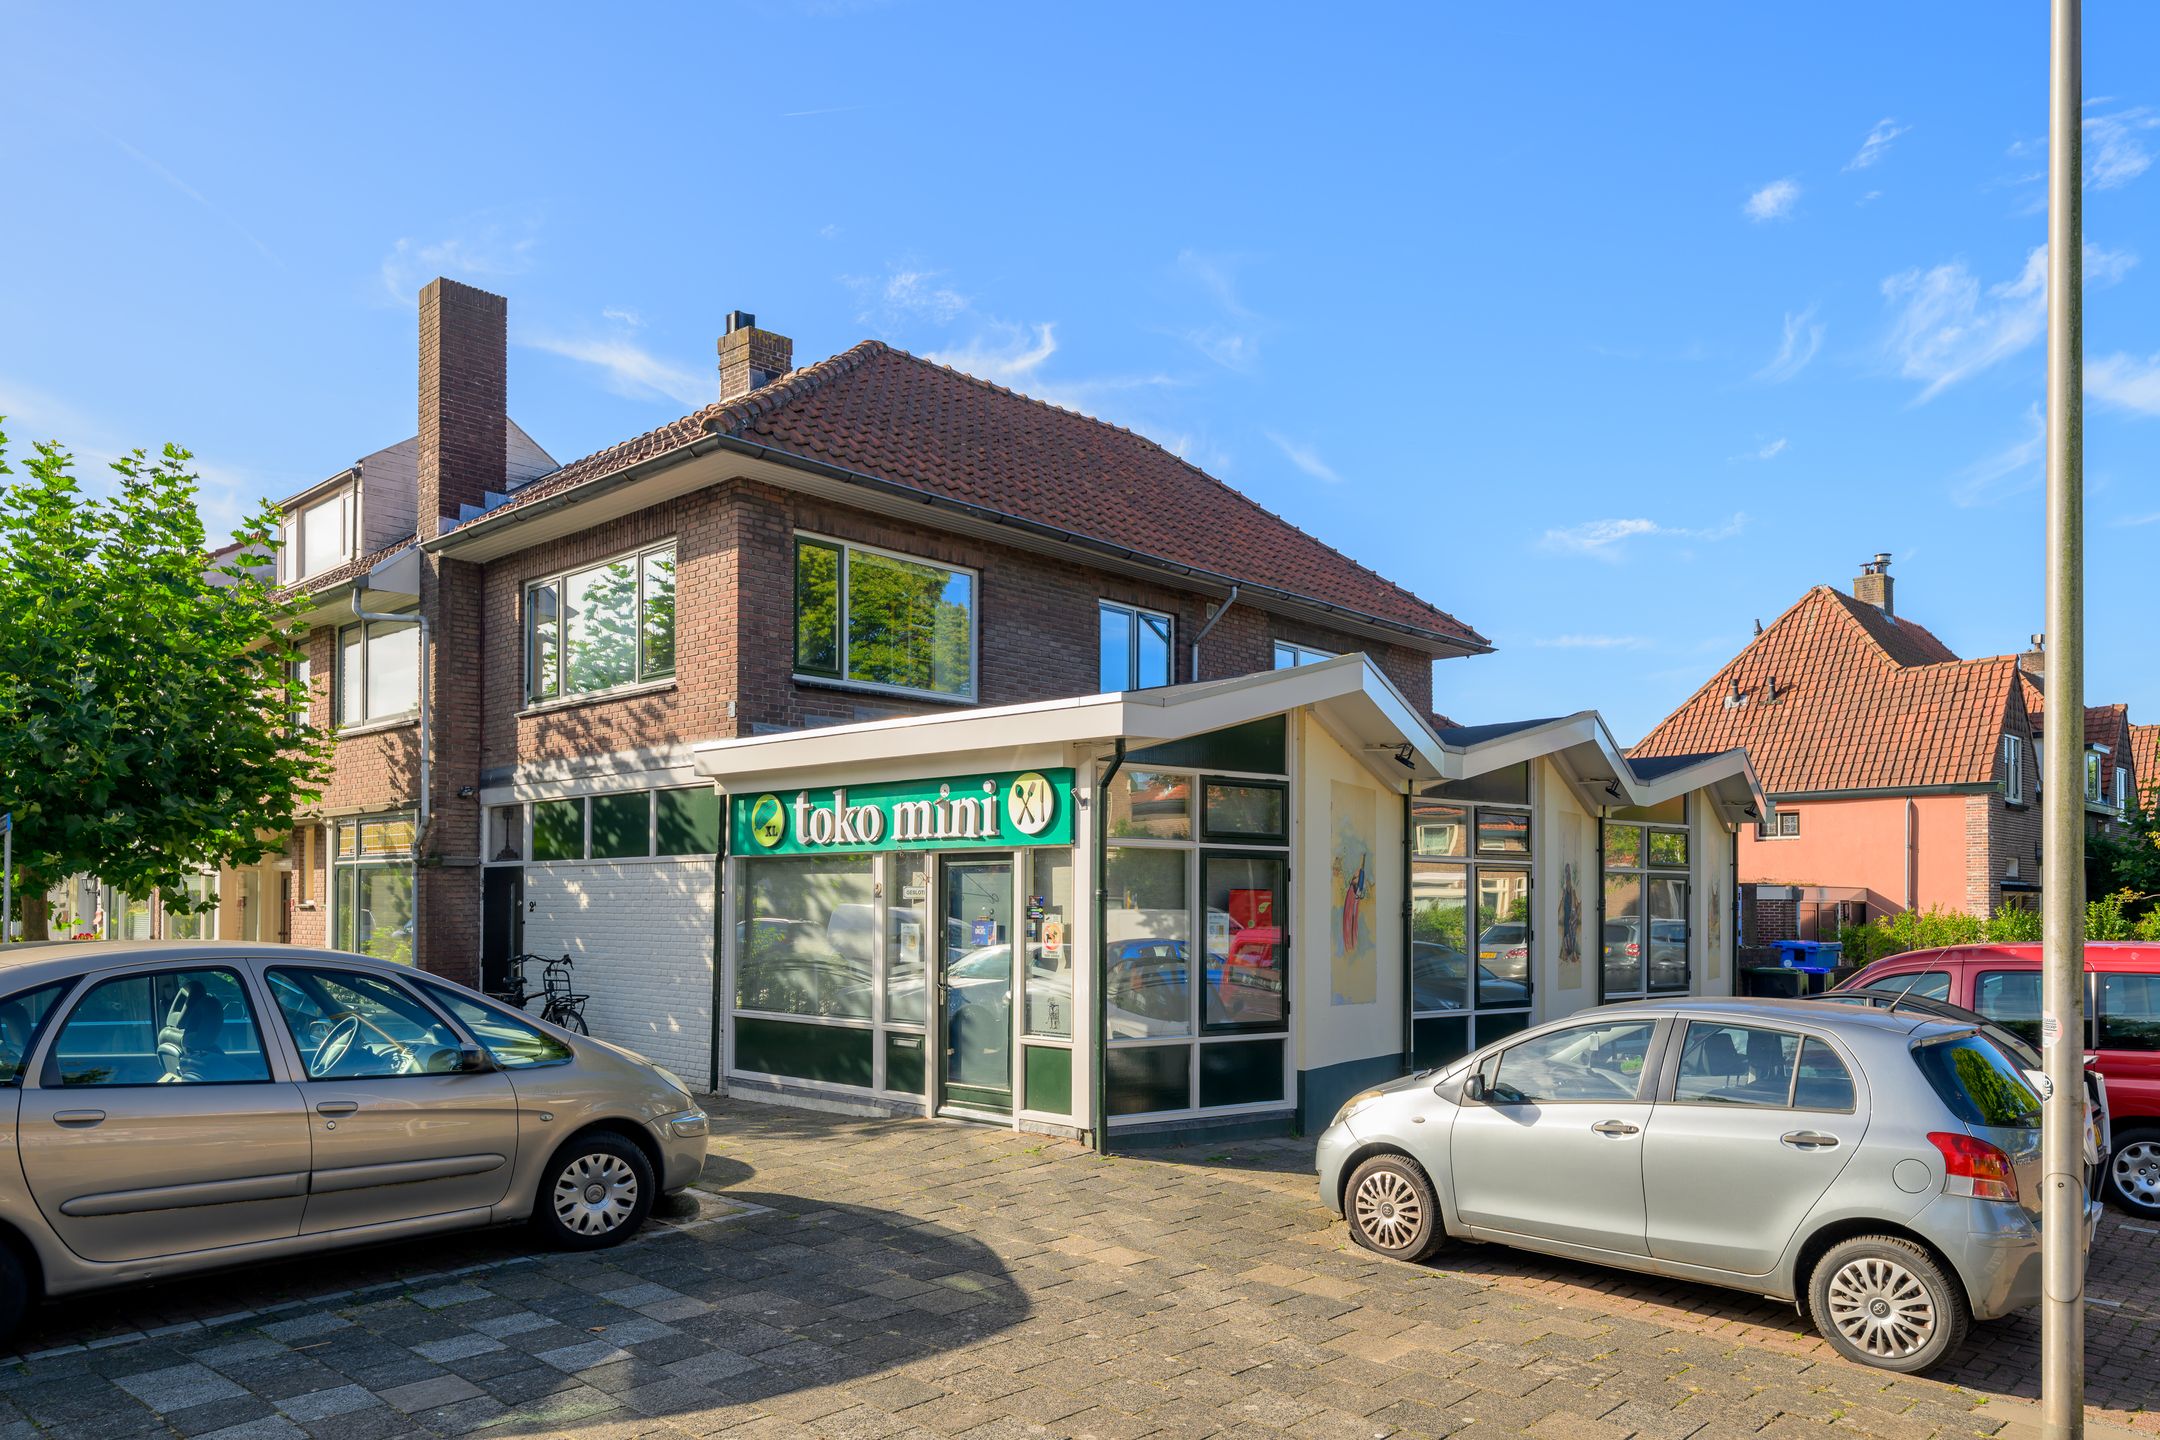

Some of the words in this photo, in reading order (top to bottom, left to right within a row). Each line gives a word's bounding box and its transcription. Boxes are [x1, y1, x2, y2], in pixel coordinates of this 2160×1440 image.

[765, 825, 778, 837] XL
[793, 788, 884, 845] toko
[890, 779, 1000, 841] mini
